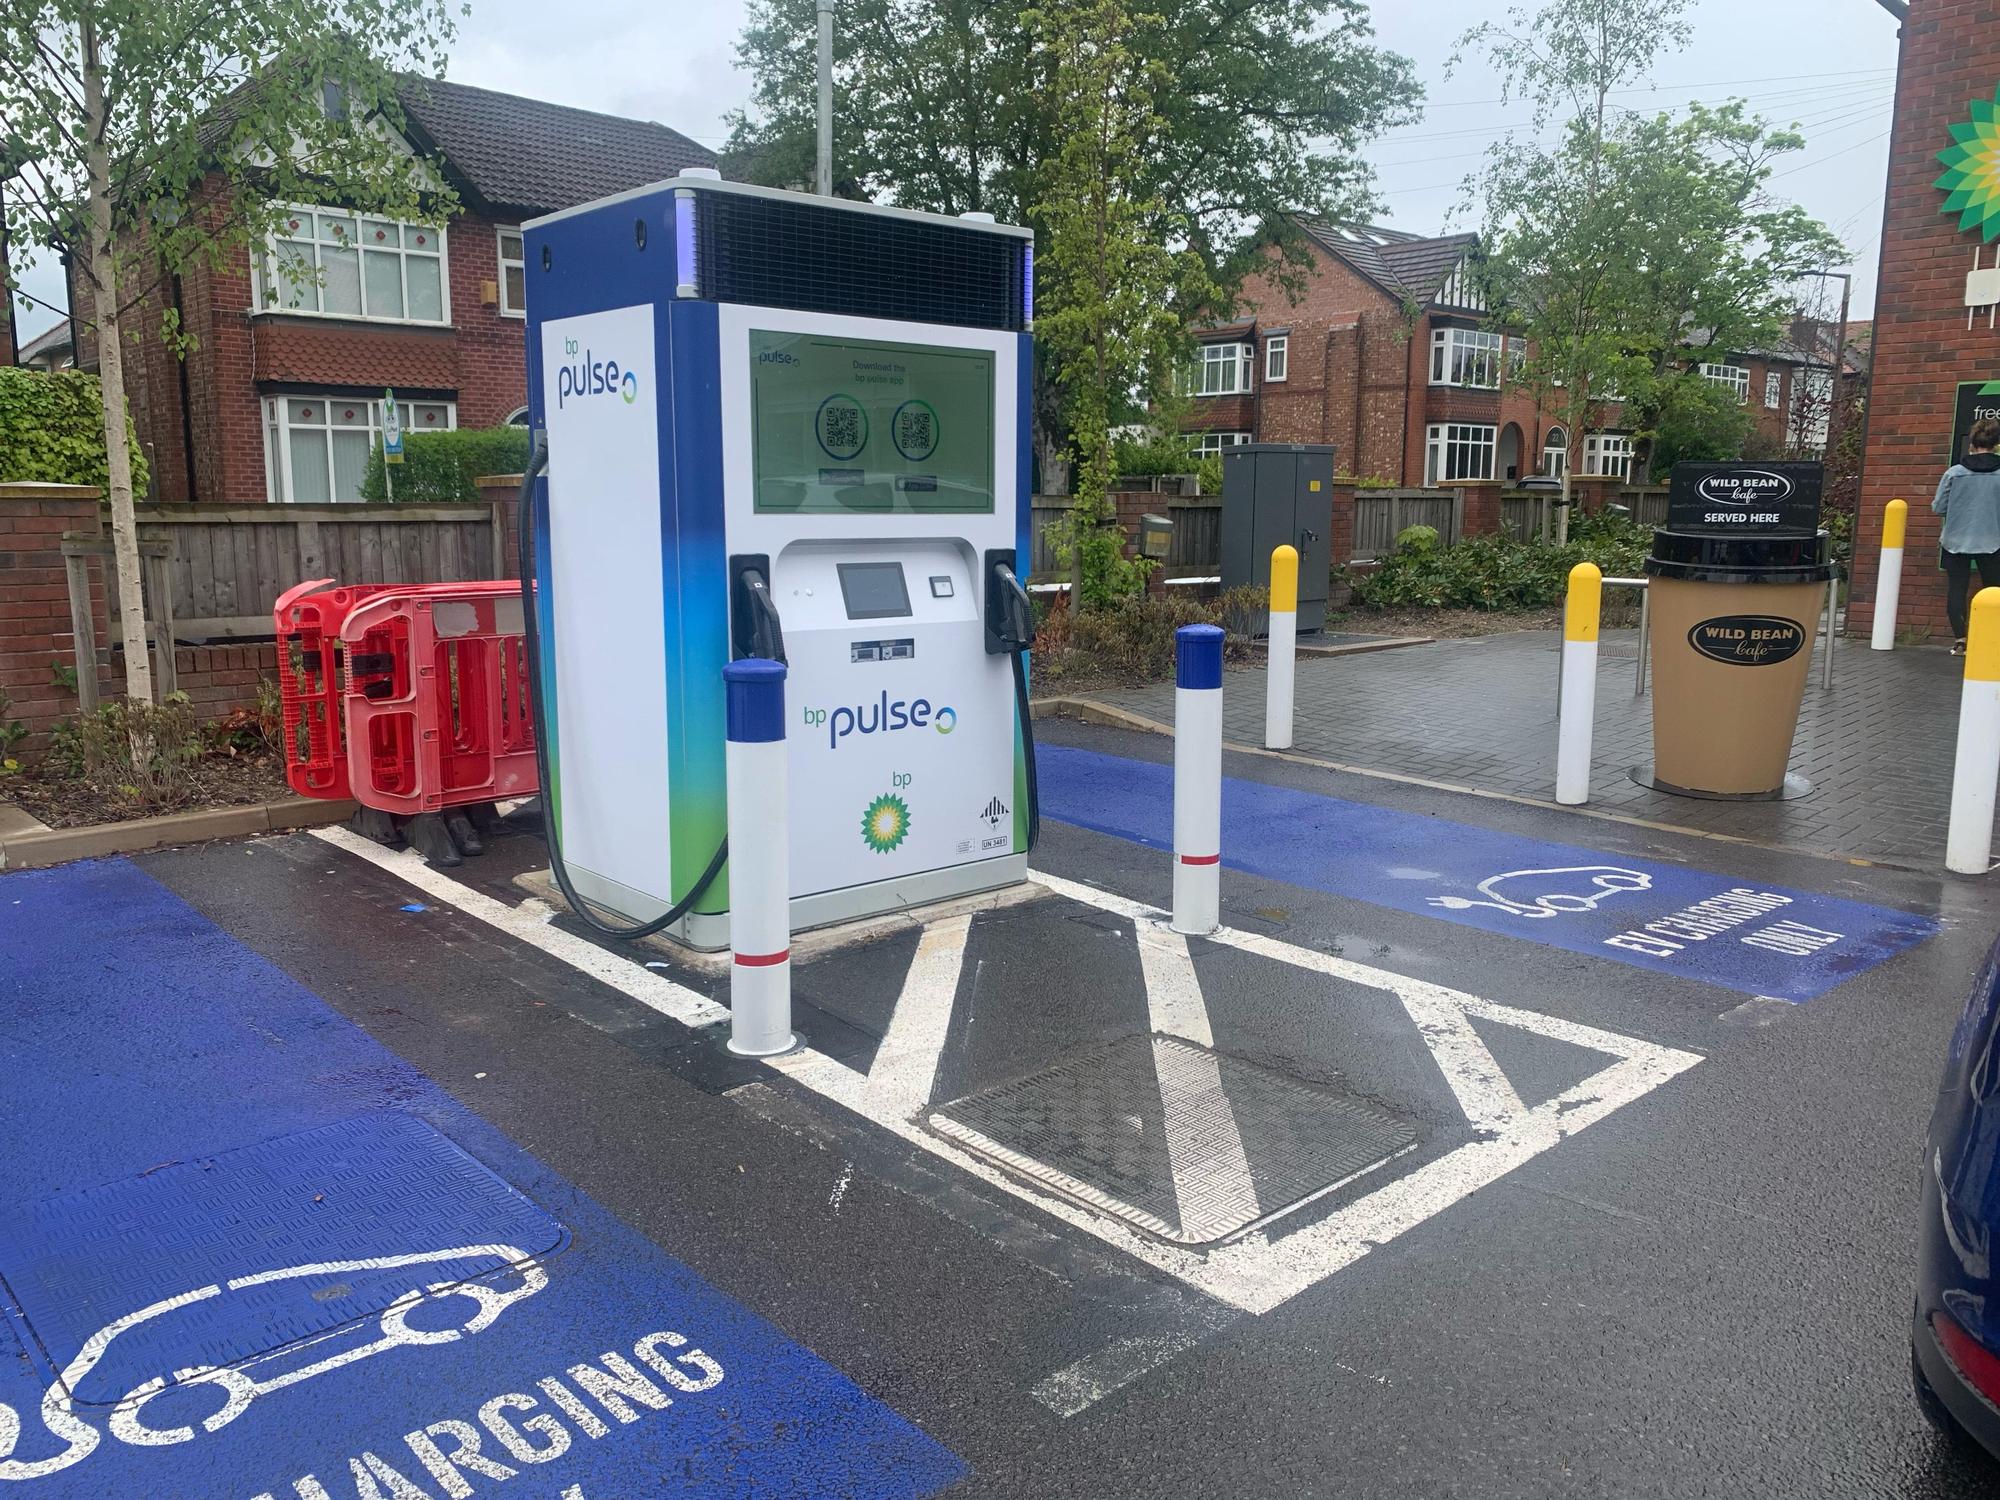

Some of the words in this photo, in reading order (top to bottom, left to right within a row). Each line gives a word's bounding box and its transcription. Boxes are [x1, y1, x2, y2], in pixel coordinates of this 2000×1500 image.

[565, 336, 579, 360] bp
[759, 350, 792, 365] pulse
[852, 360, 892, 372] Download
[559, 349, 619, 409] pulse
[855, 374, 866, 384] bp
[1709, 479, 1740, 487] WILD
[1743, 479, 1779, 487] BEAN
[1704, 513, 1747, 523] SERVED
[1750, 513, 1780, 523] HERE
[1705, 627, 1746, 640] WILD
[1750, 628, 1793, 640] BEAN
[804, 707, 826, 727] bp
[830, 690, 931, 749] pulse
[892, 771, 912, 789] bp
[1603, 930, 1686, 957] EV
[1645, 888, 1794, 942] CHARGING
[1741, 919, 1846, 957] ONLY
